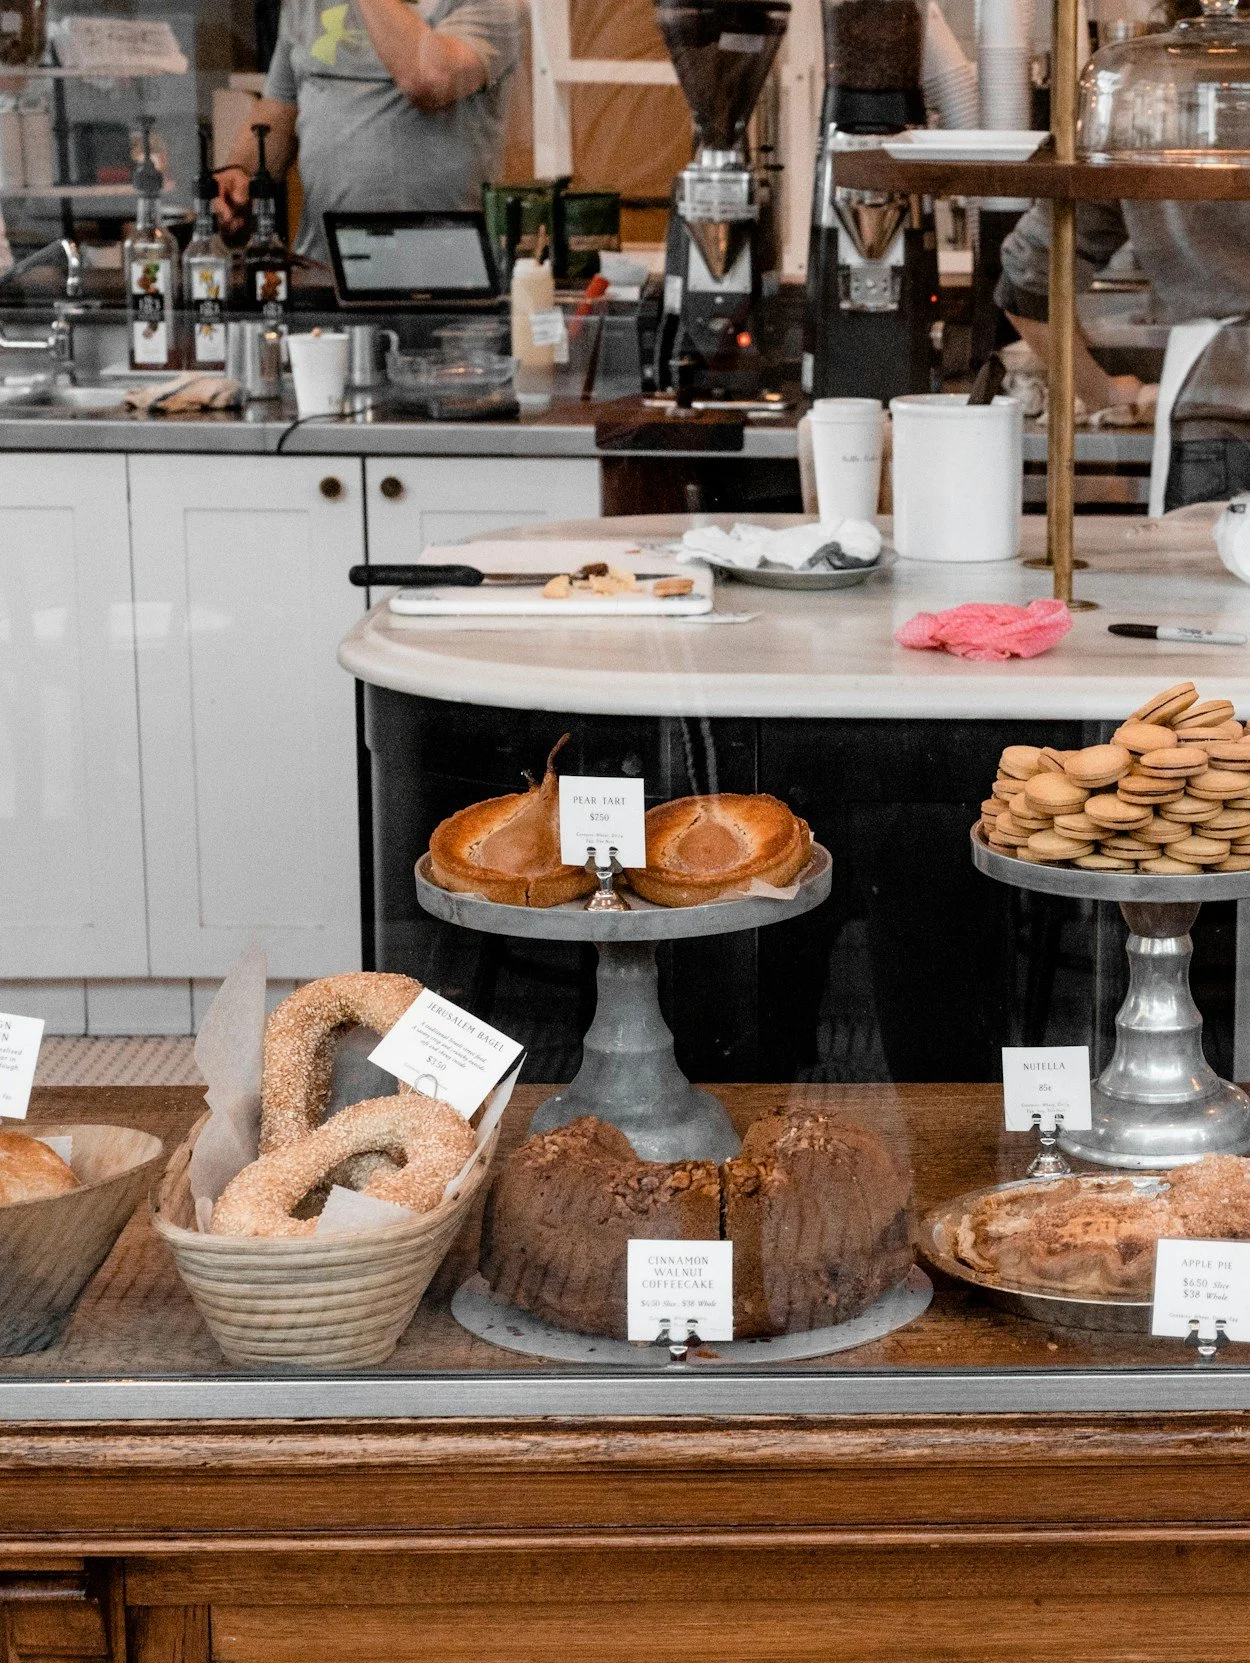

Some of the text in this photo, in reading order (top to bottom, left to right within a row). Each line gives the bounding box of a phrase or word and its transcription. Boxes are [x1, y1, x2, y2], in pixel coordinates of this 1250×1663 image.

[573, 796, 626, 805] PEAR TART
[427, 1002, 504, 1052] JERUSALEM BAGEL
[1023, 1062, 1066, 1071] NUTELLA
[648, 1256, 709, 1265] CINNAMON
[1181, 1259, 1233, 1270] APPLE PIE
[654, 1268, 702, 1277] WALNUT
[642, 1280, 714, 1289] COFFEECAKE
[1183, 1289, 1228, 1301] $38 Whole
